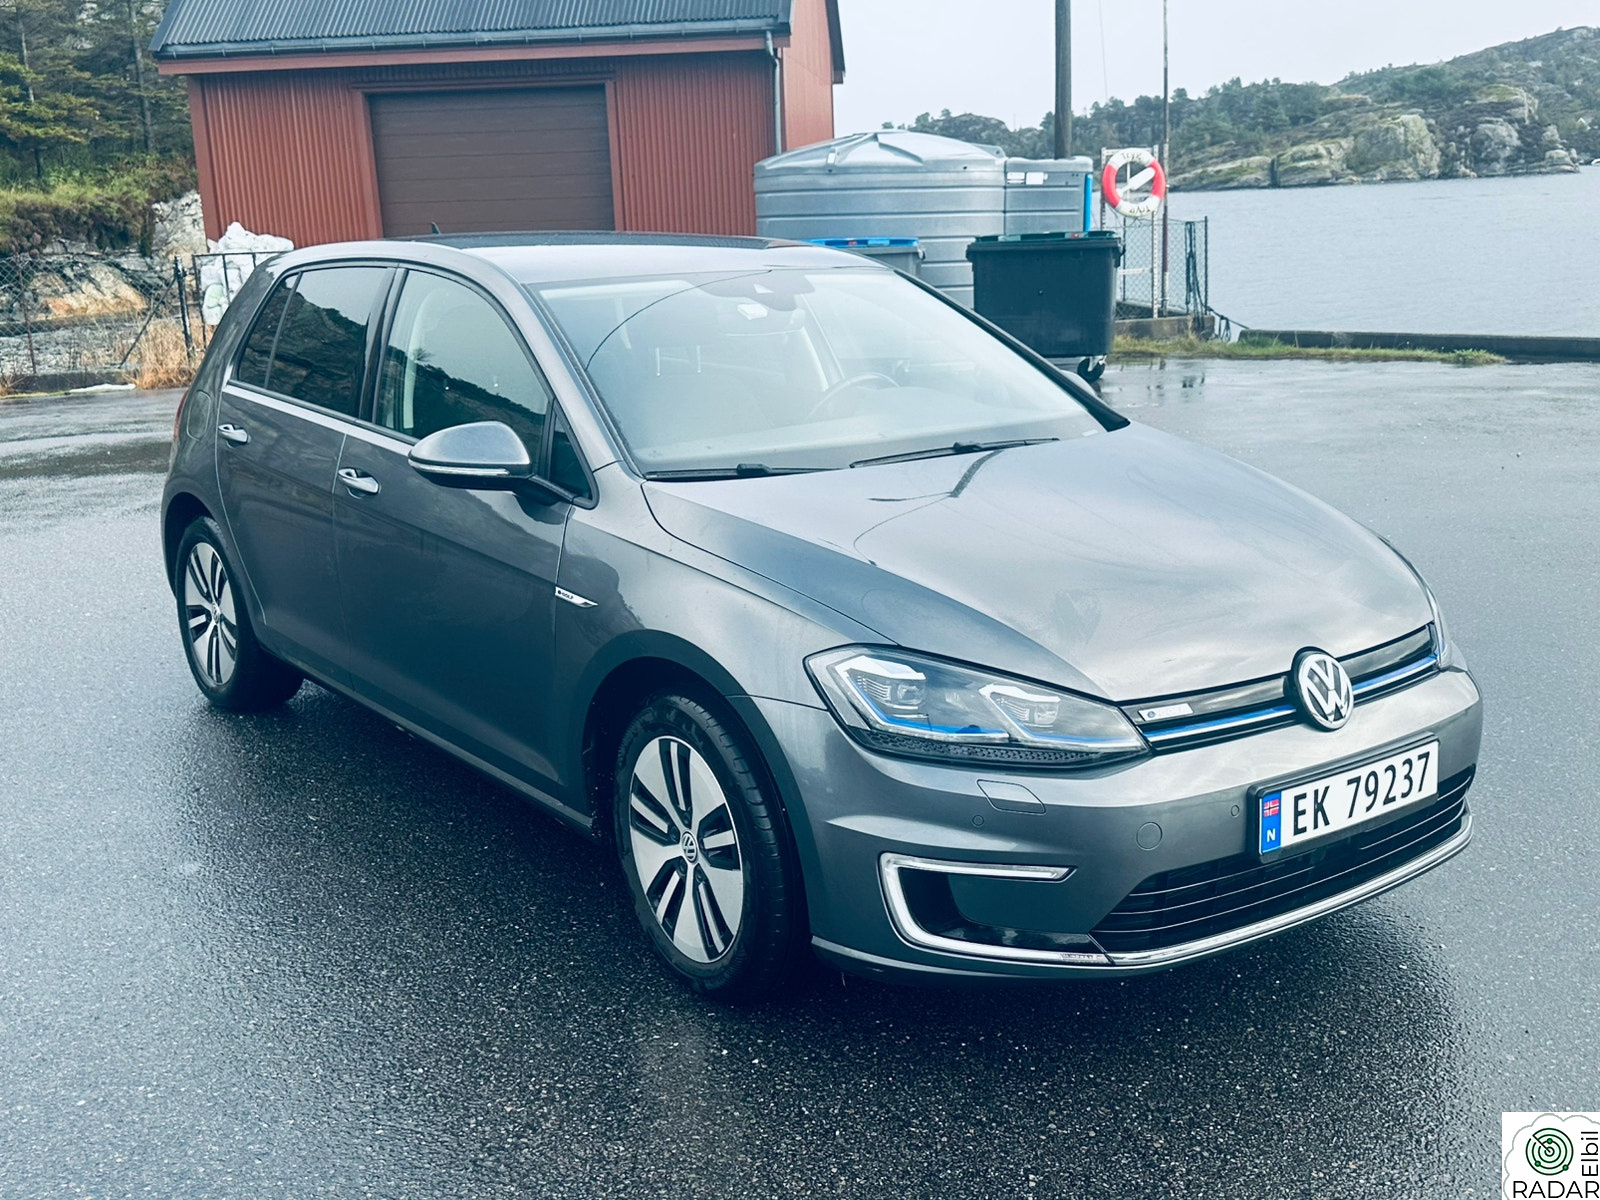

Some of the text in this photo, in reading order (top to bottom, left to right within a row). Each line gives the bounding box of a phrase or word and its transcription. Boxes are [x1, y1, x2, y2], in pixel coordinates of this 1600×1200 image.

[1293, 751, 1430, 836] EK 79237
[1266, 828, 1276, 842] N
